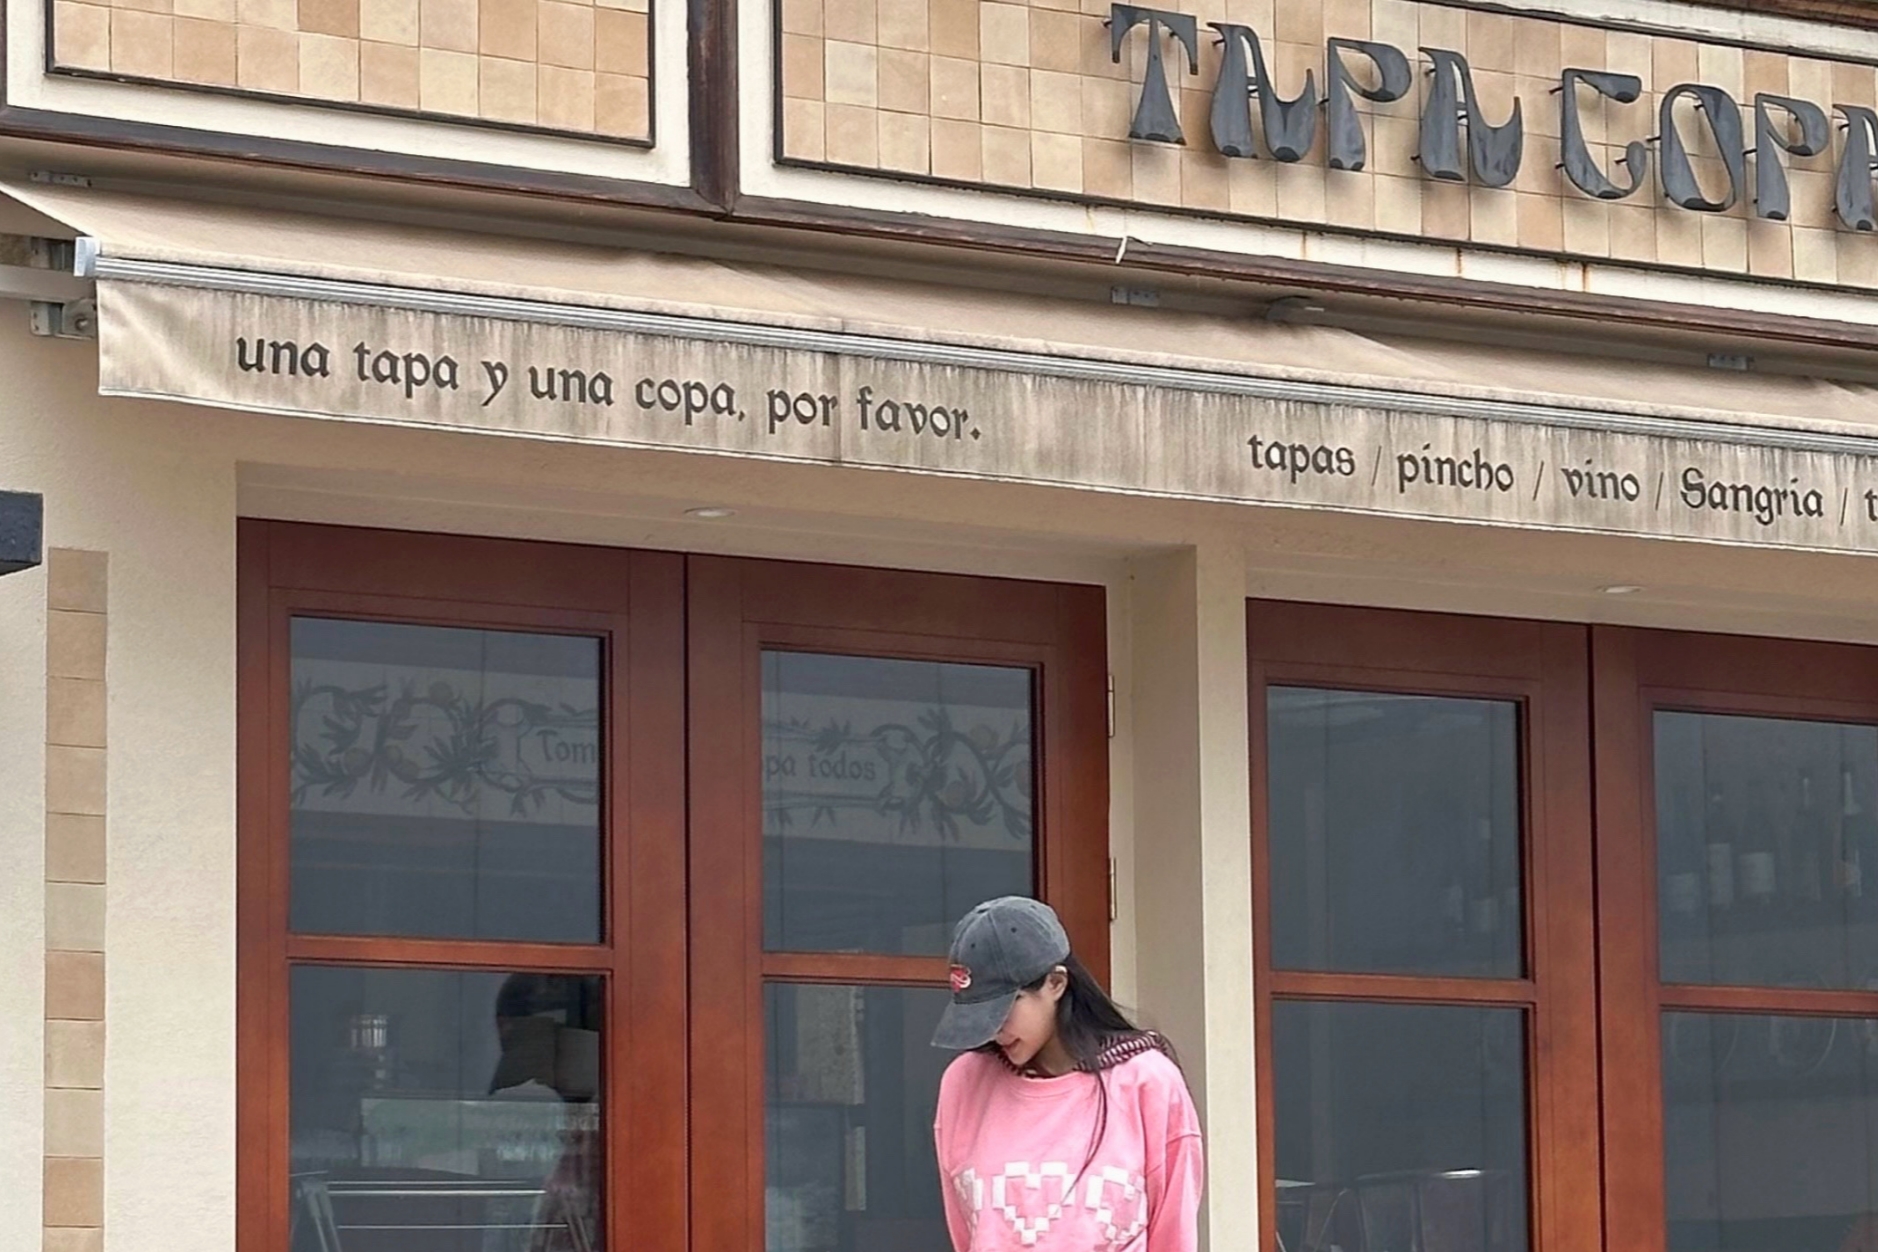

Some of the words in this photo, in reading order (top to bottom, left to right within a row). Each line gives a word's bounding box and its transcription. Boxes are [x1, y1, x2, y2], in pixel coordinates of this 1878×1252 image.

[1110, 4, 1524, 188] TAPA
[237, 336, 330, 378] una
[353, 341, 459, 399] tapa
[481, 360, 508, 406] y
[528, 366, 614, 407] una
[635, 377, 746, 426] copa,
[767, 389, 838, 434] por
[856, 385, 982, 441] favor.
[1247, 434, 1356, 484] tapas
[1397, 443, 1515, 494] pincho
[1560, 458, 1641, 502] vino
[1680, 466, 1824, 526] Sangria
